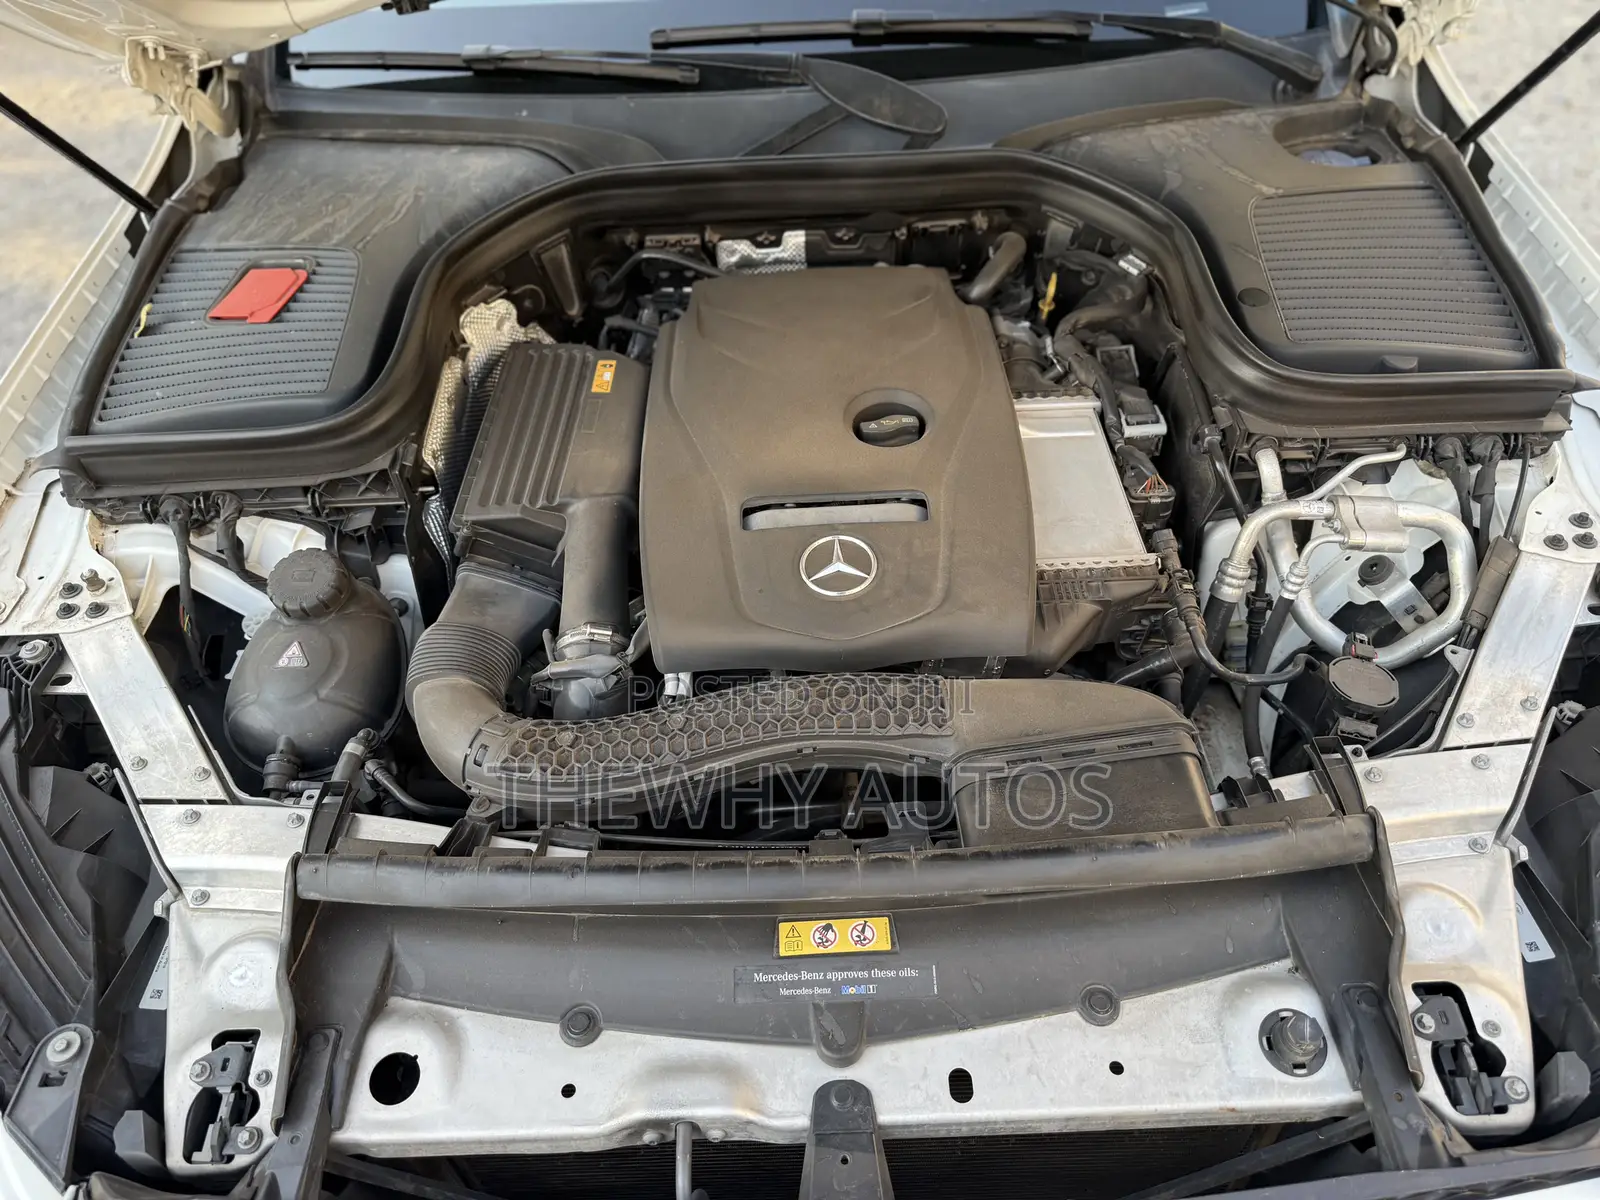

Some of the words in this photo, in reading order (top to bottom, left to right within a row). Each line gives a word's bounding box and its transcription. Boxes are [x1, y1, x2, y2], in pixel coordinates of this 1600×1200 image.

[753, 970, 824, 982] Mercedes-Benz
[826, 970, 869, 982] approves
[871, 967, 897, 978] these
[898, 966, 919, 978] oils:
[779, 986, 832, 997] Mercedes-Benz
[841, 984, 867, 995] Mobil
